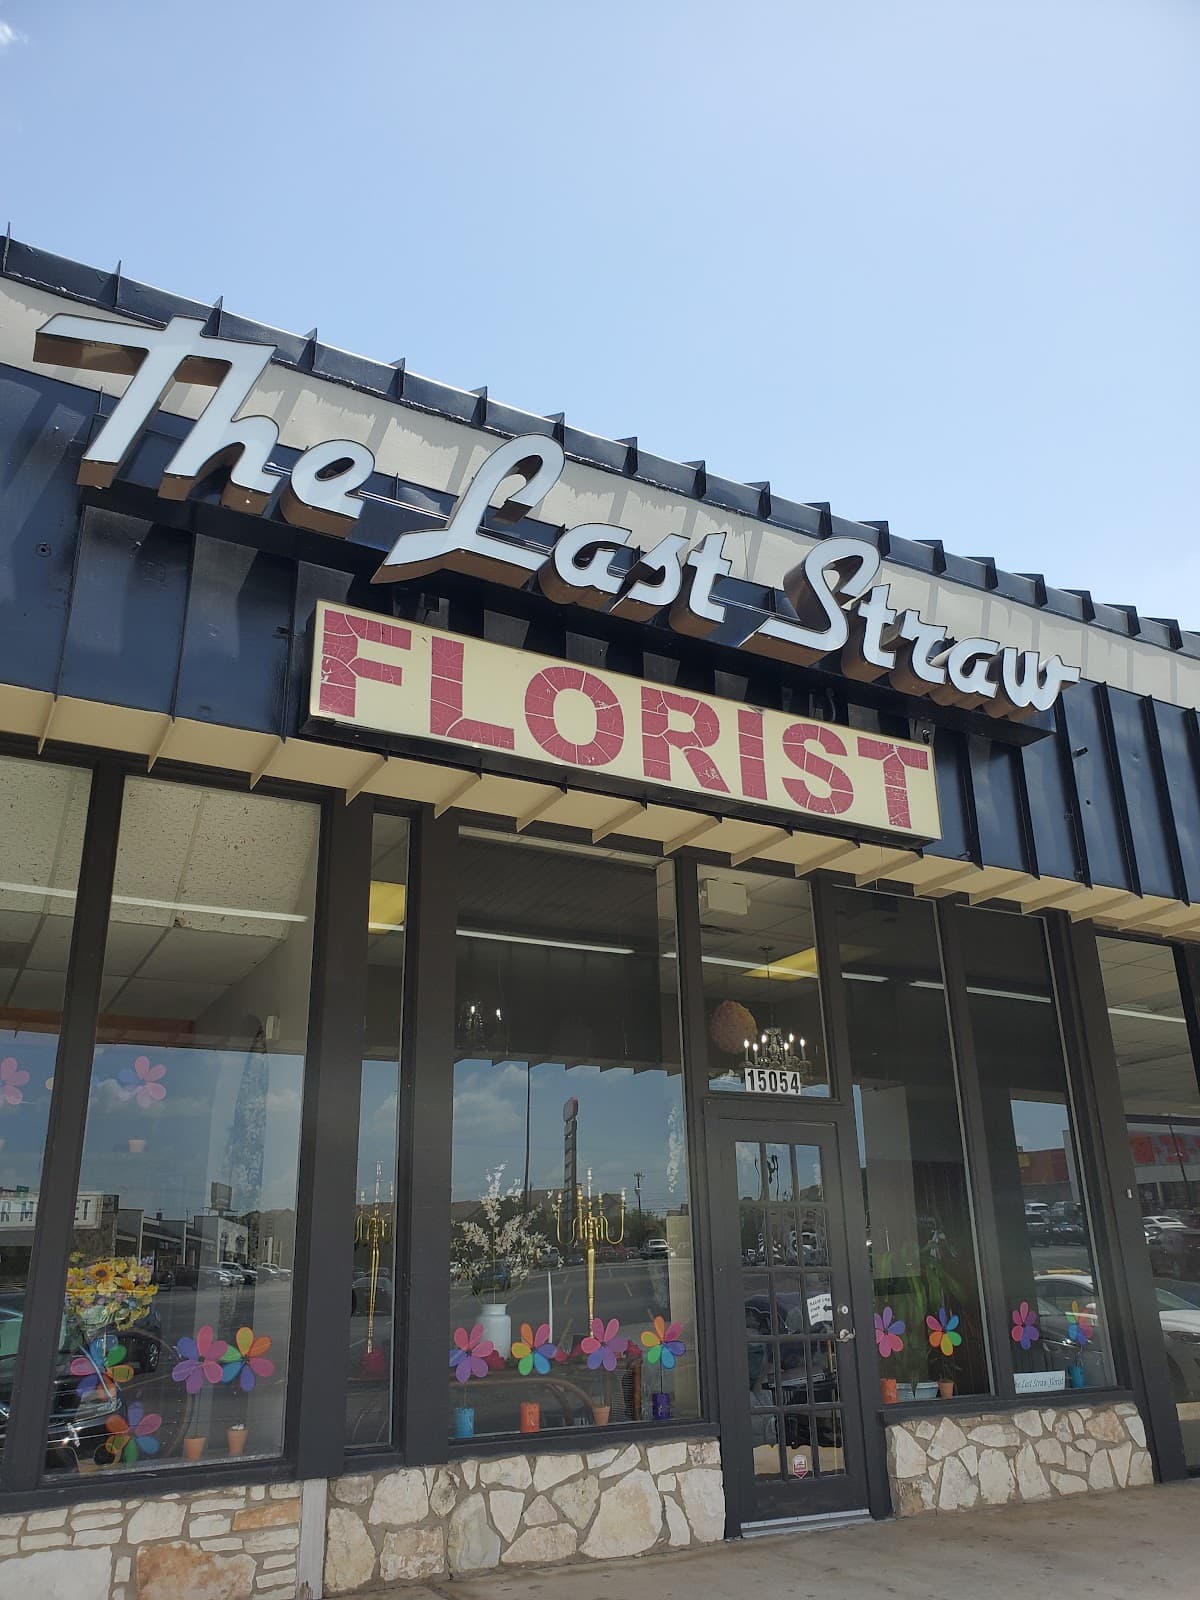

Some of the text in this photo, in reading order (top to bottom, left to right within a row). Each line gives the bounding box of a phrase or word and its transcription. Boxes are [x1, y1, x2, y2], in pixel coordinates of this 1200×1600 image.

[35, 313, 1081, 712] The Last Straw
[319, 609, 929, 830] FLORIST
[747, 1069, 800, 1094] 15054
